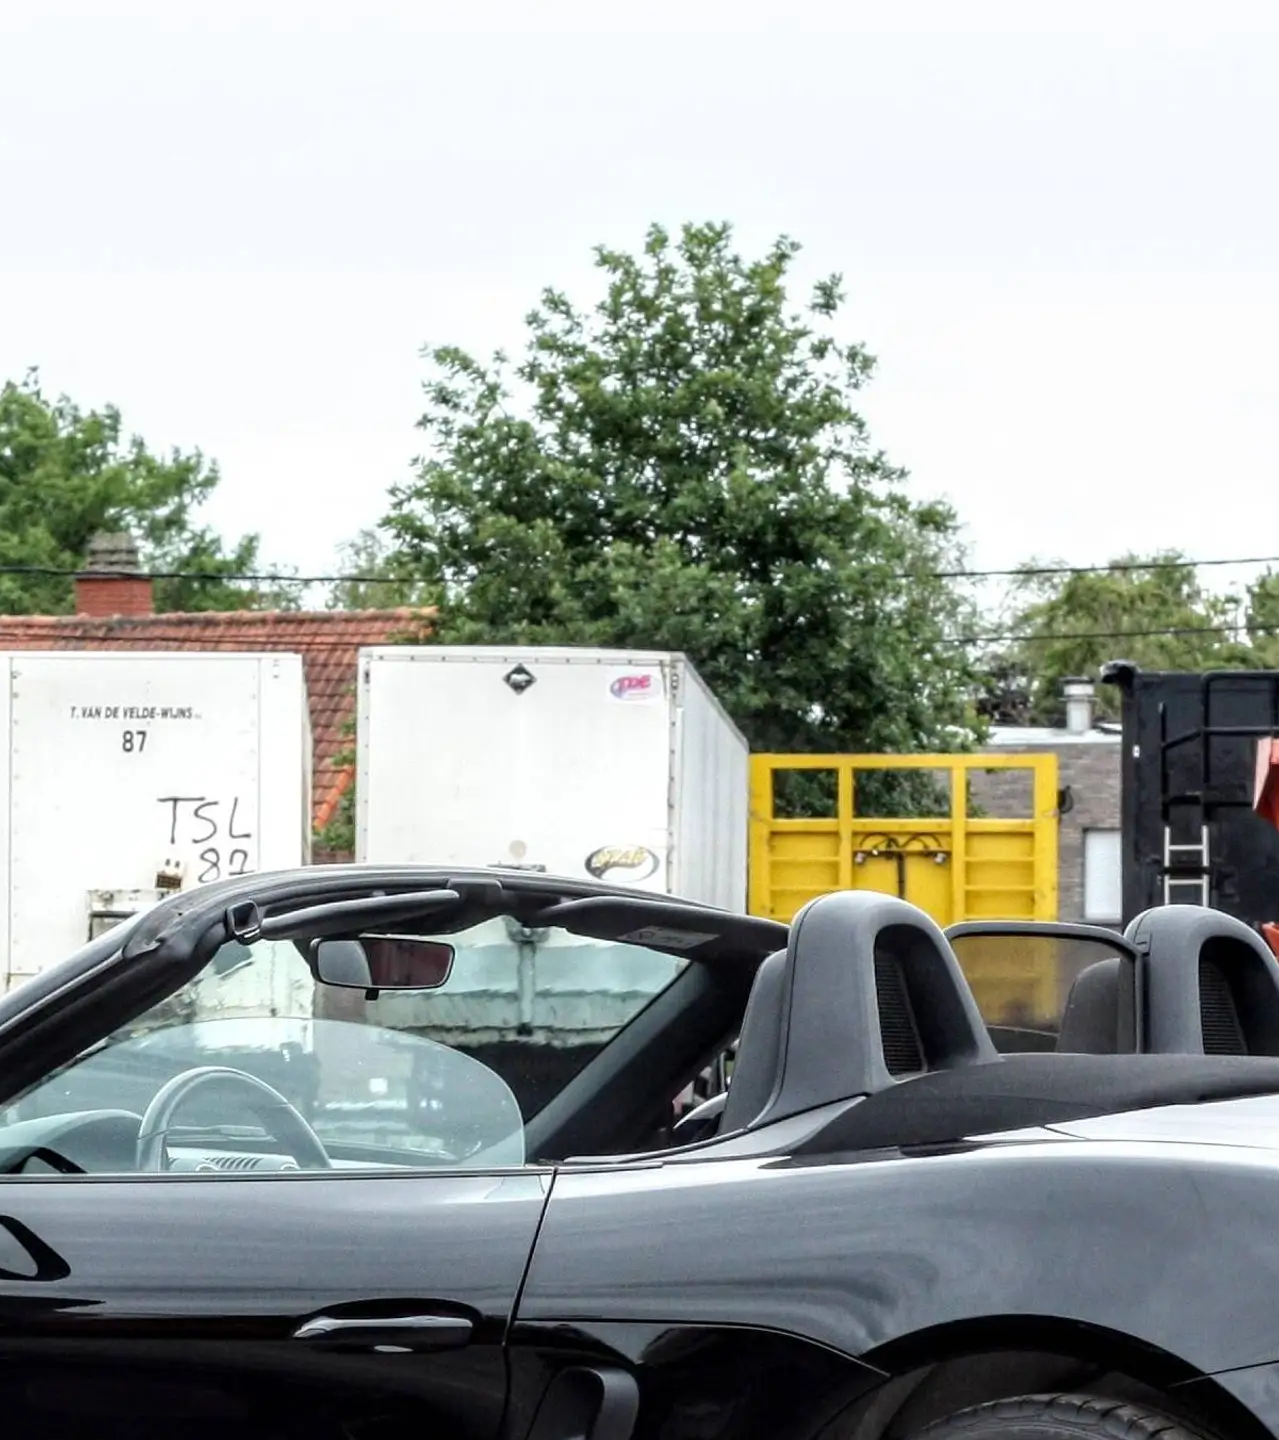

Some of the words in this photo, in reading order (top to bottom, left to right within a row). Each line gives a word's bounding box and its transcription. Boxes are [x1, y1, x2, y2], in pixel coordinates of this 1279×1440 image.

[105, 706, 119, 719] DE
[122, 730, 147, 752] 87
[156, 796, 251, 844] TSL
